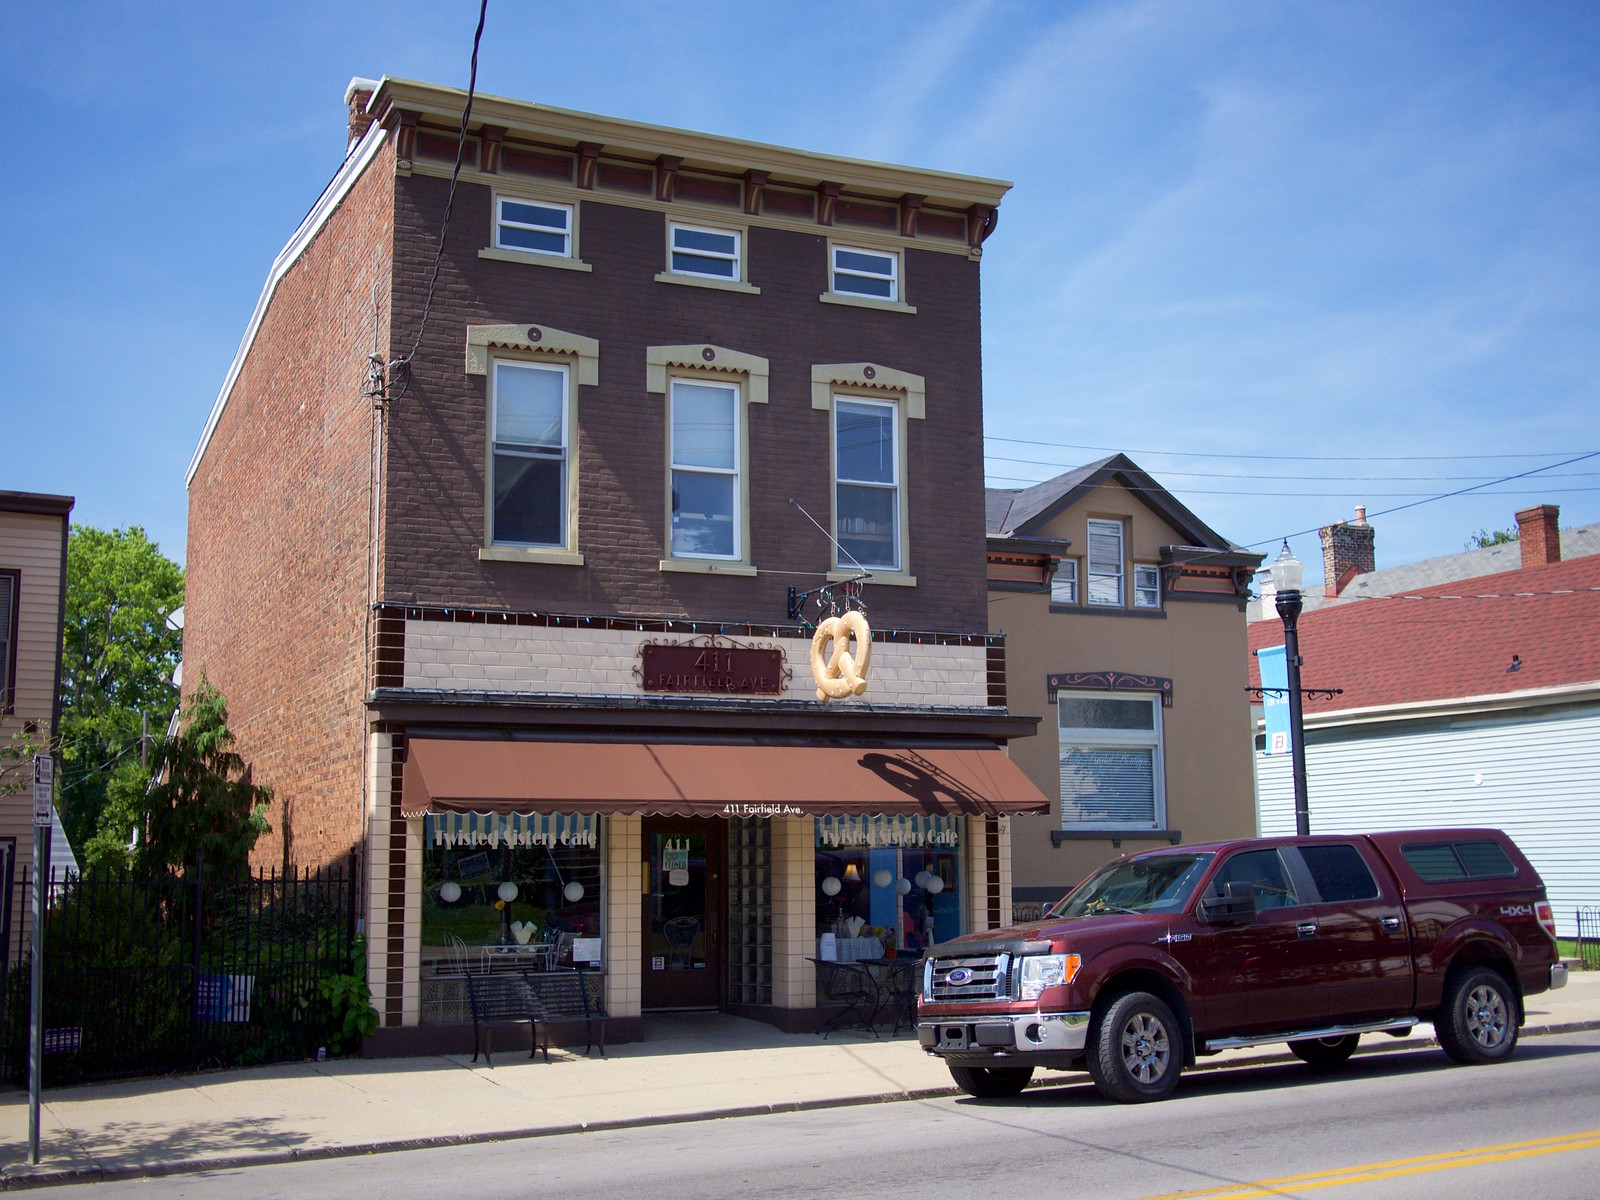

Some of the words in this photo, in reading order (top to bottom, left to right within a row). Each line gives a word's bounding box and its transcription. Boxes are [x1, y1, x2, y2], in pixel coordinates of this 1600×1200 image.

[694, 650, 733, 673] 411
[659, 674, 733, 688] FAIRFIELD
[741, 676, 767, 689] AVE
[723, 804, 740, 813] 411
[743, 804, 781, 814] Fairfield
[783, 804, 804, 814] Ave.
[434, 829, 499, 847] Twisted
[503, 829, 557, 847] Sisters
[560, 829, 597, 846] Cafe
[665, 838, 690, 851] 411
[821, 829, 876, 846] Twisted
[879, 829, 925, 846] Sisters
[927, 829, 958, 845] Cafe
